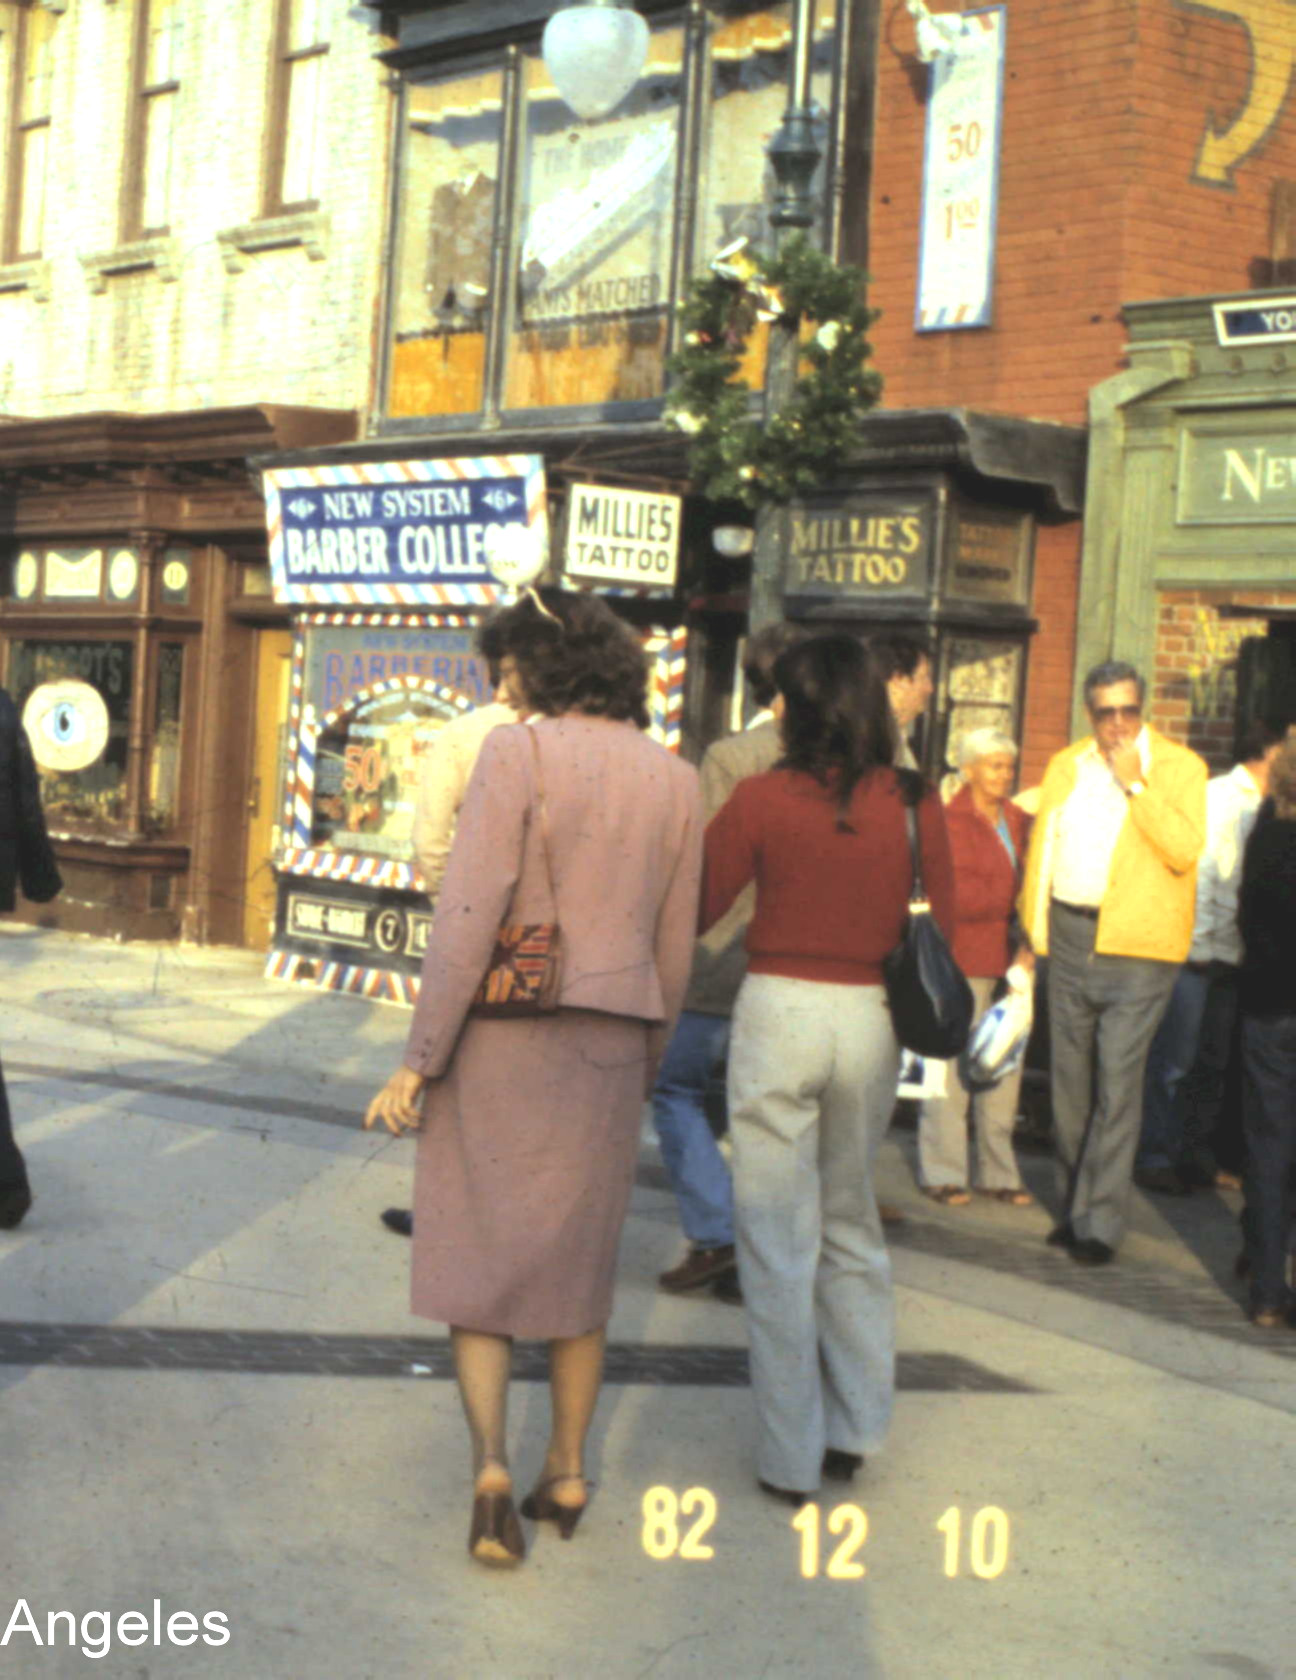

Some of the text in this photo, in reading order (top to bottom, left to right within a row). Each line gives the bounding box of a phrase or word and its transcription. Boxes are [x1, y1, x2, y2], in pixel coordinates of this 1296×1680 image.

[947, 120, 981, 162] 50
[323, 489, 374, 521] NEW
[381, 486, 471, 517] SYSTEM
[286, 522, 530, 575] BARBER COLLE
[791, 515, 921, 554] MILLIE'S
[576, 542, 671, 573] TATTOO
[800, 552, 907, 584] TATTOO
[342, 744, 382, 792] 50
[385, 917, 397, 942] 7
